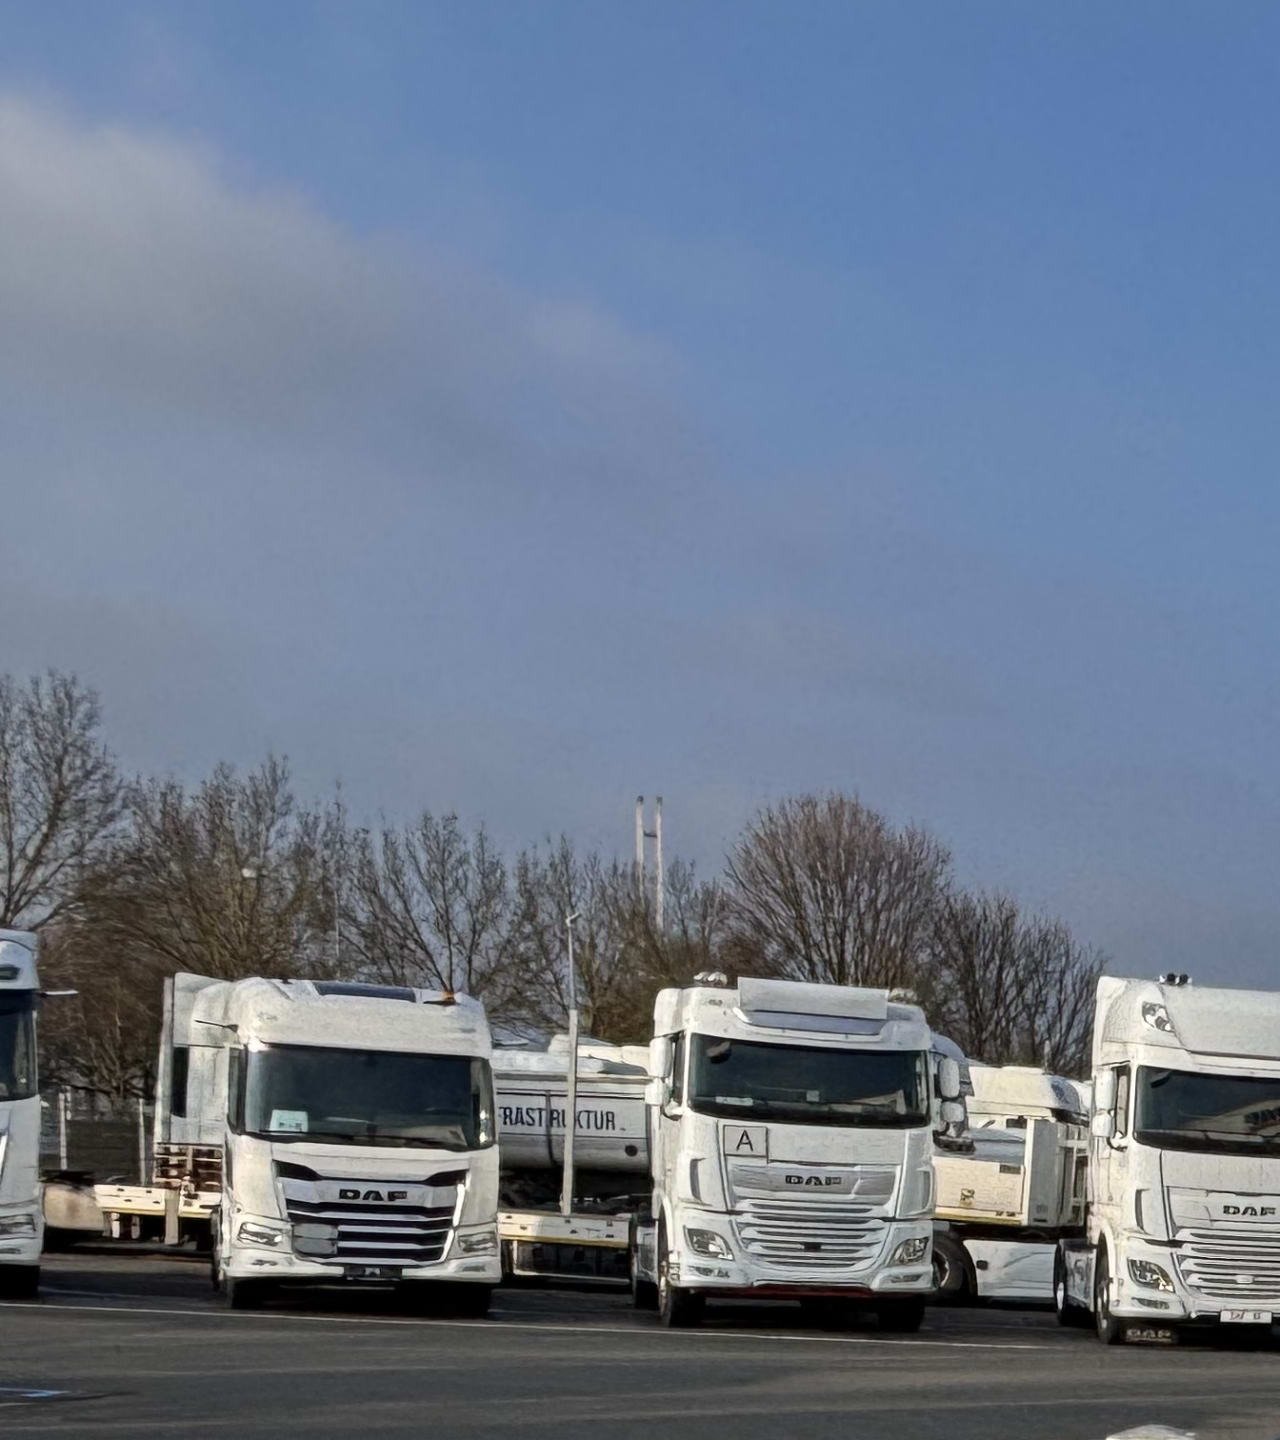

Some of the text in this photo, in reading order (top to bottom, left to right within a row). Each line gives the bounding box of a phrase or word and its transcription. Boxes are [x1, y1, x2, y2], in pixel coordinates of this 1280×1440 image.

[736, 1129, 754, 1152] A
[785, 1174, 842, 1187] DAF
[339, 1188, 407, 1202] DAF
[1223, 1205, 1277, 1217] DAF
